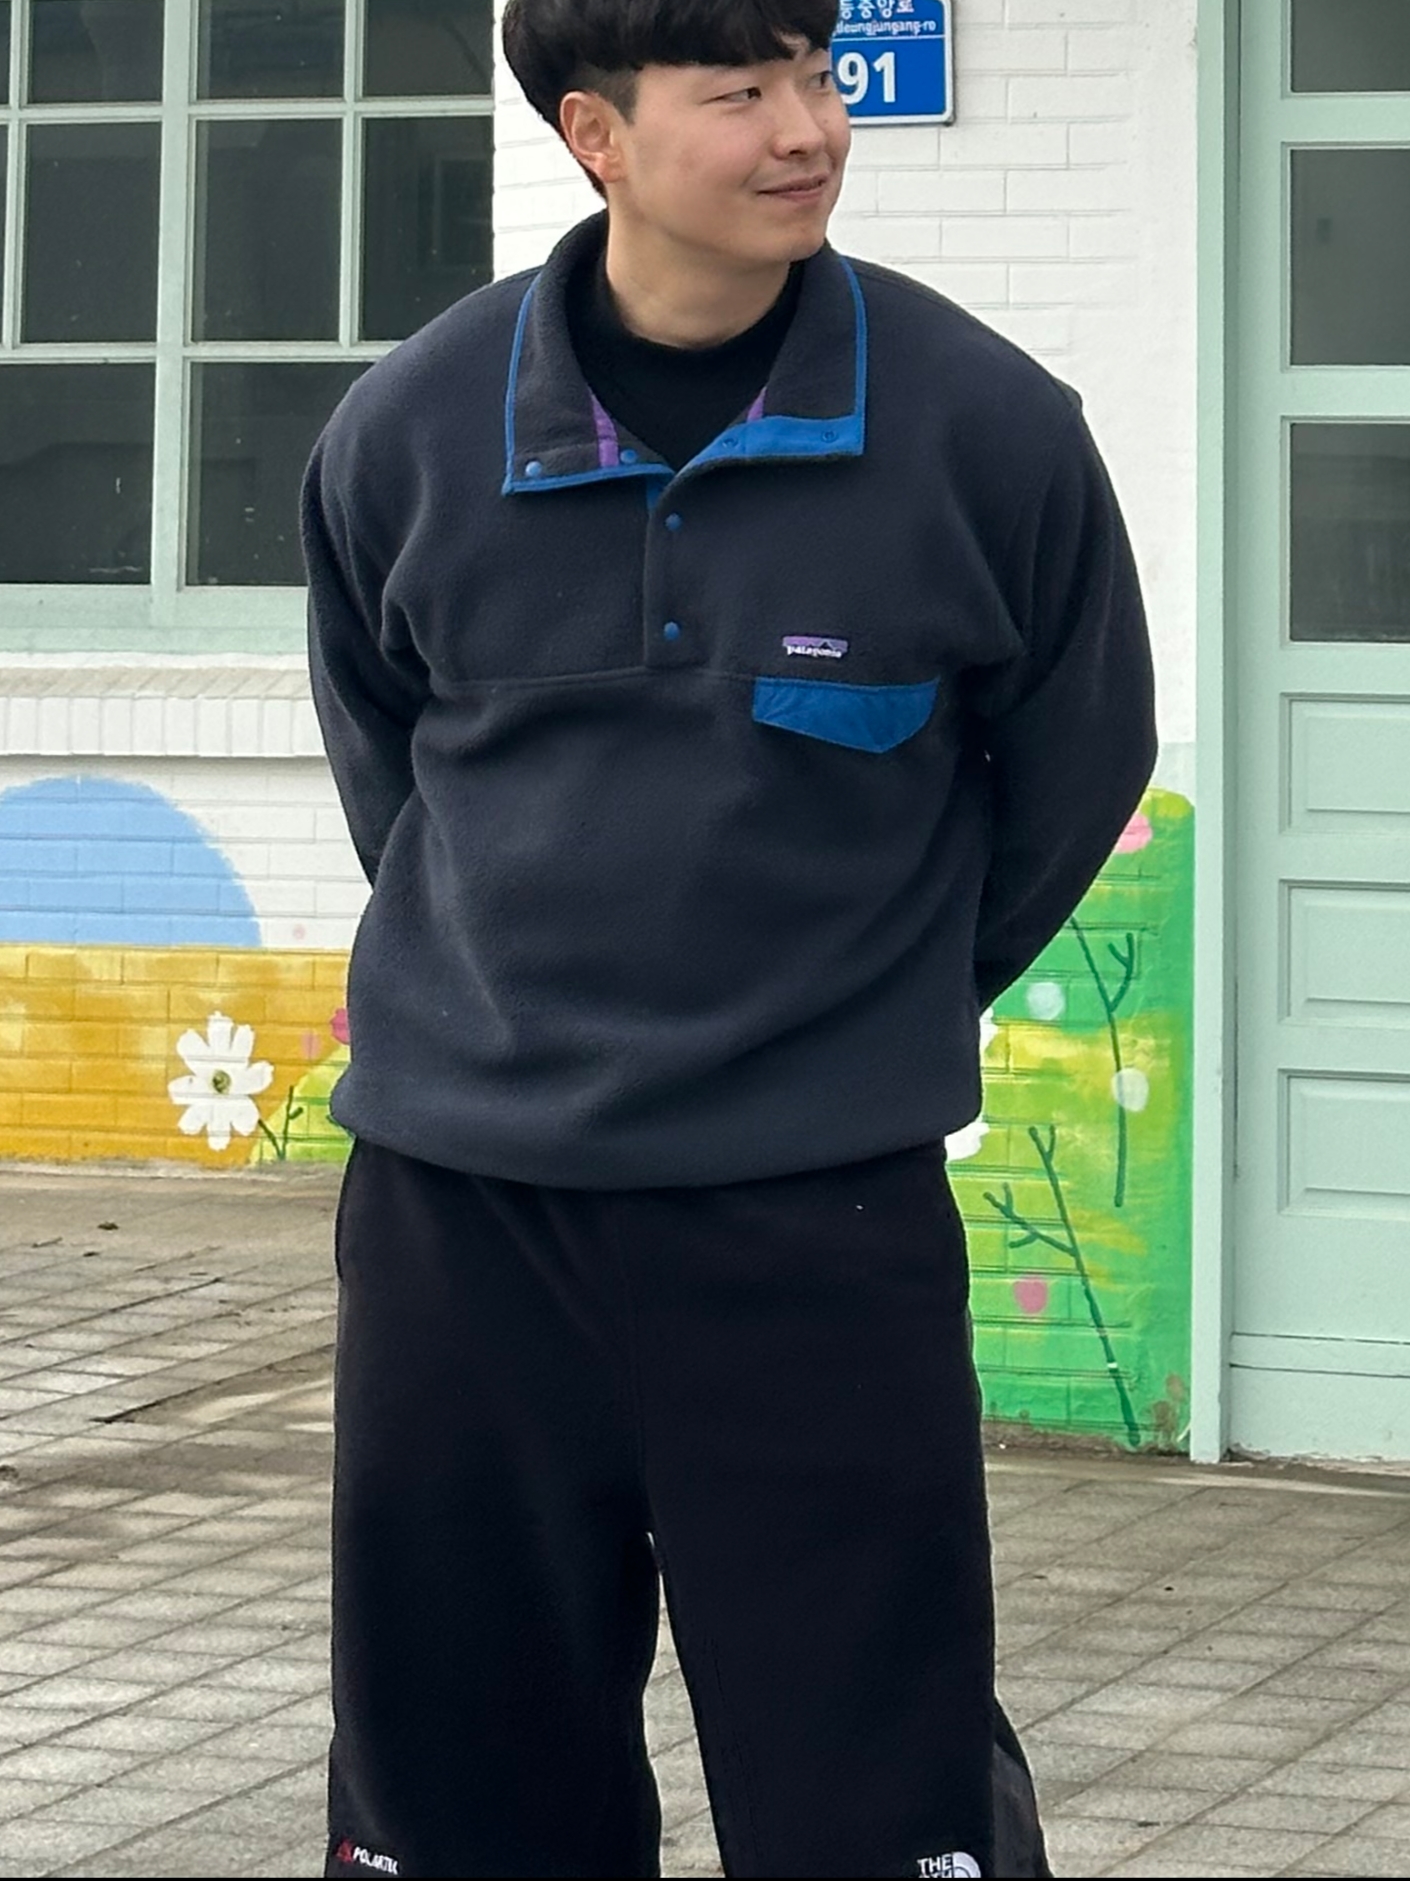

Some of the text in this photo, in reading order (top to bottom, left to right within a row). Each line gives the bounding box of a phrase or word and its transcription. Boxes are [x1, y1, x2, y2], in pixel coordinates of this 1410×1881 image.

[832, 20, 936, 37] deungjungang-ro
[838, 52, 896, 104] 91
[917, 1853, 952, 1875] THE
